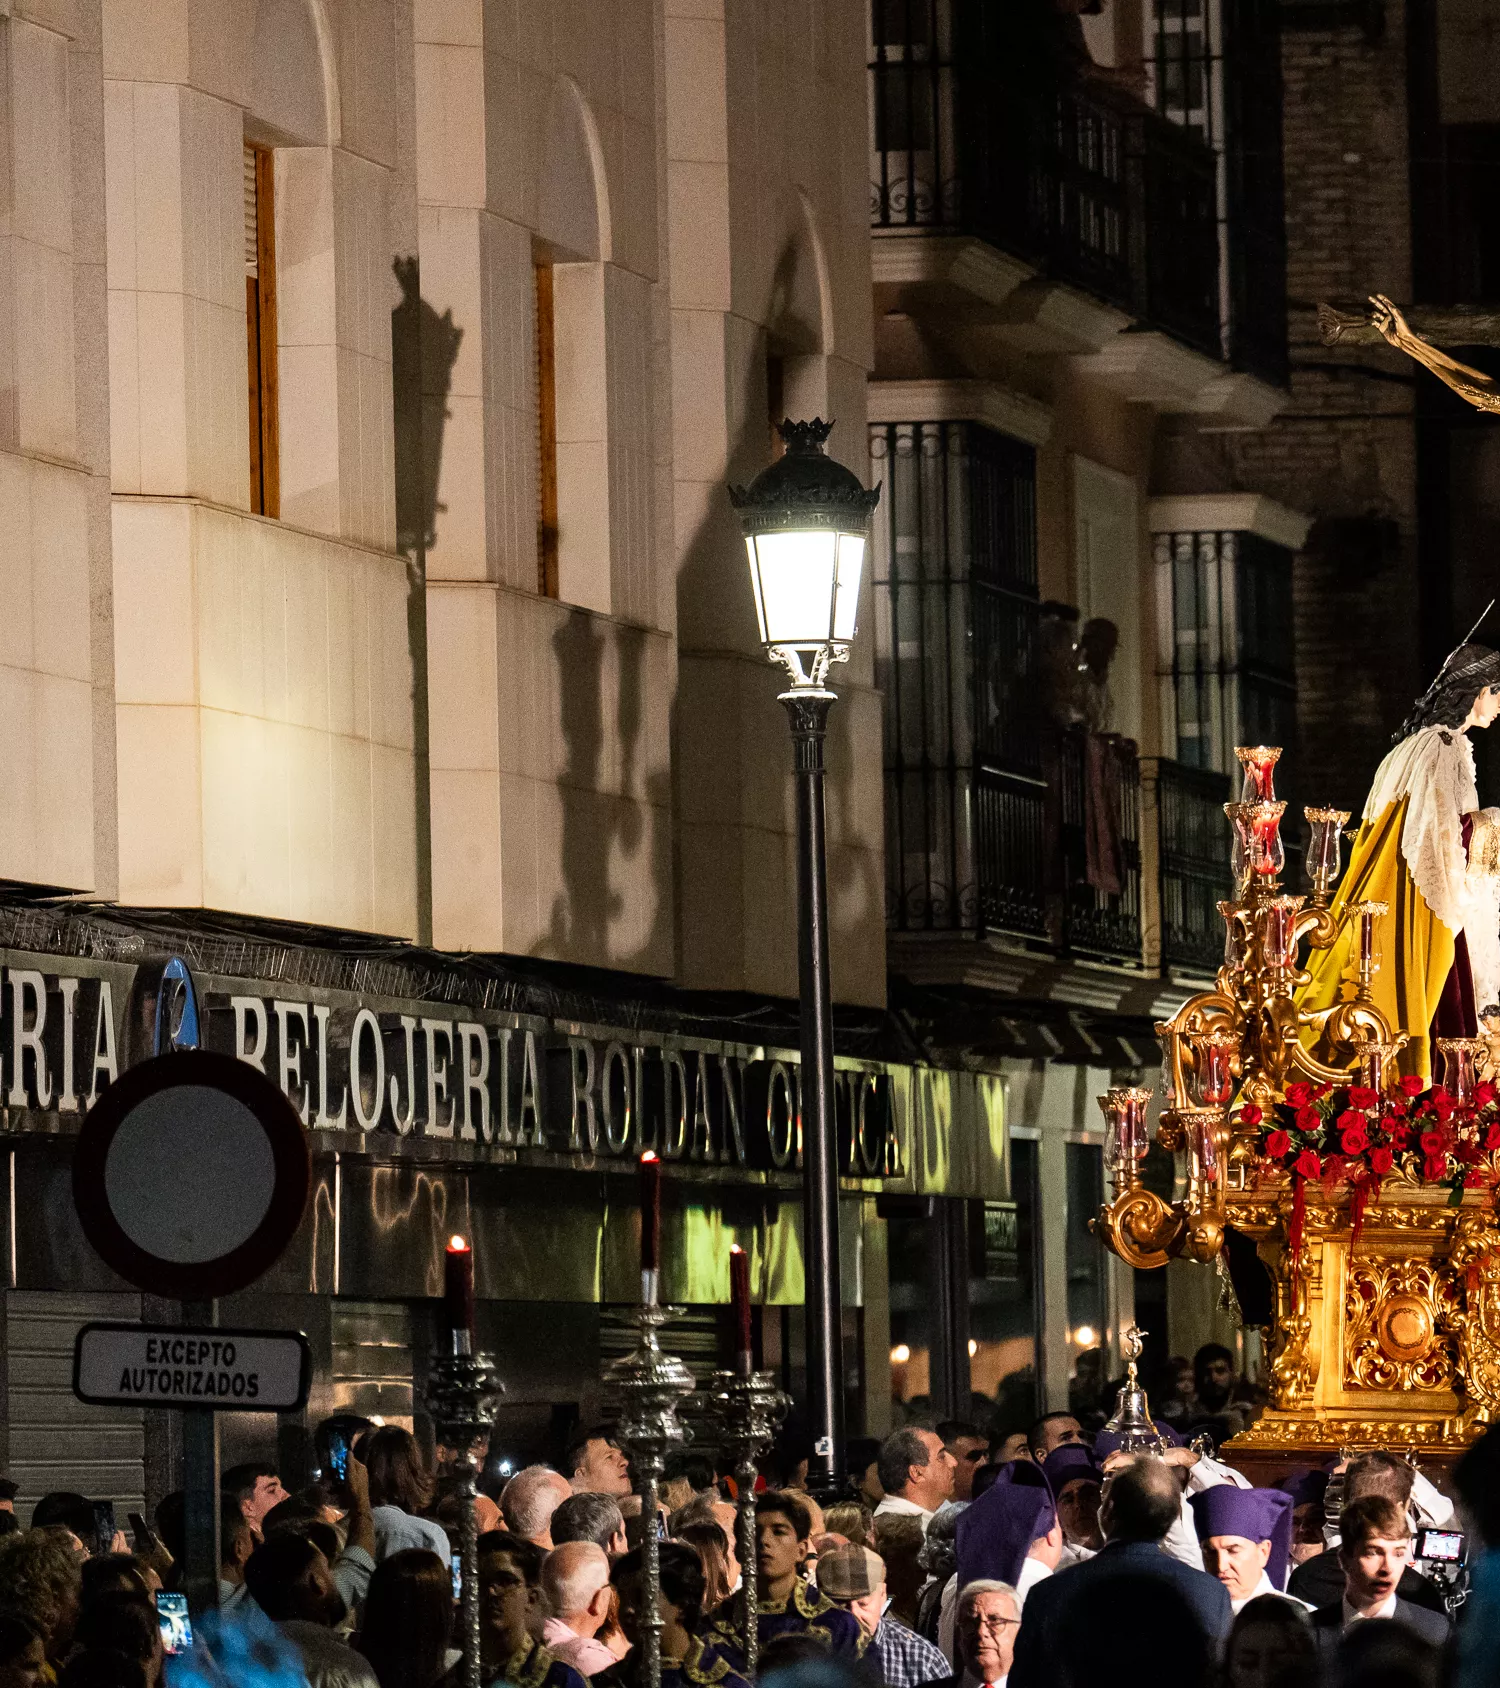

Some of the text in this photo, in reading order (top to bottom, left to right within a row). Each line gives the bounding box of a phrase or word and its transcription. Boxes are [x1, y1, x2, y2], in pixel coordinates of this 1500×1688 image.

[0, 968, 118, 1113] RIA
[230, 995, 547, 1147] RELOJERIA
[567, 1036, 748, 1164] ROLDAN
[766, 1059, 905, 1177] OICA
[146, 1339, 236, 1367] EXCEPTO
[119, 1368, 260, 1398] AUTORIZADOS
